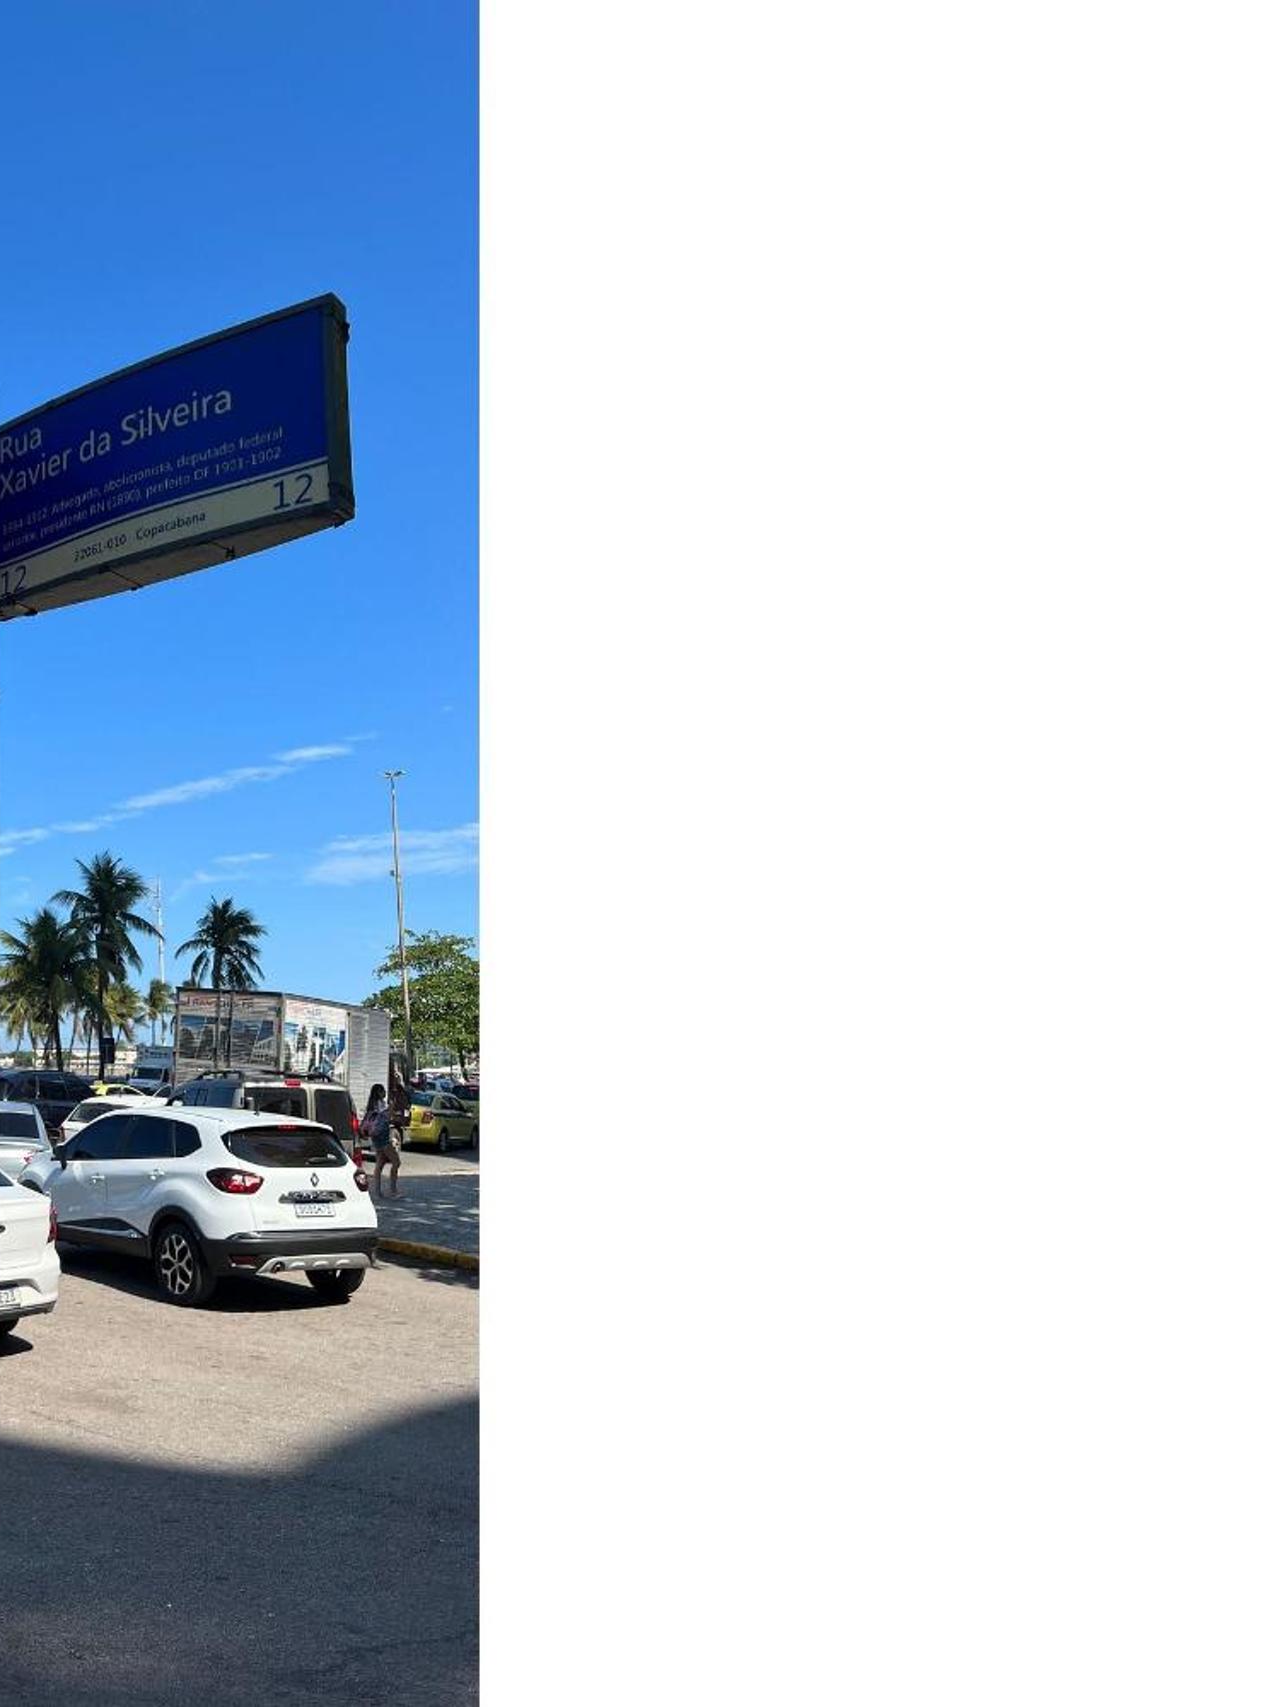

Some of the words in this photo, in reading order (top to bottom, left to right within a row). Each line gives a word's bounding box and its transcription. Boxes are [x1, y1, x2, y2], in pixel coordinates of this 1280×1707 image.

[0, 427, 42, 464] Rua
[79, 428, 111, 464] da
[120, 389, 232, 446] Silveira
[0, 564, 27, 595] 12
[135, 511, 206, 541] Copacabana
[273, 472, 314, 511] 12
